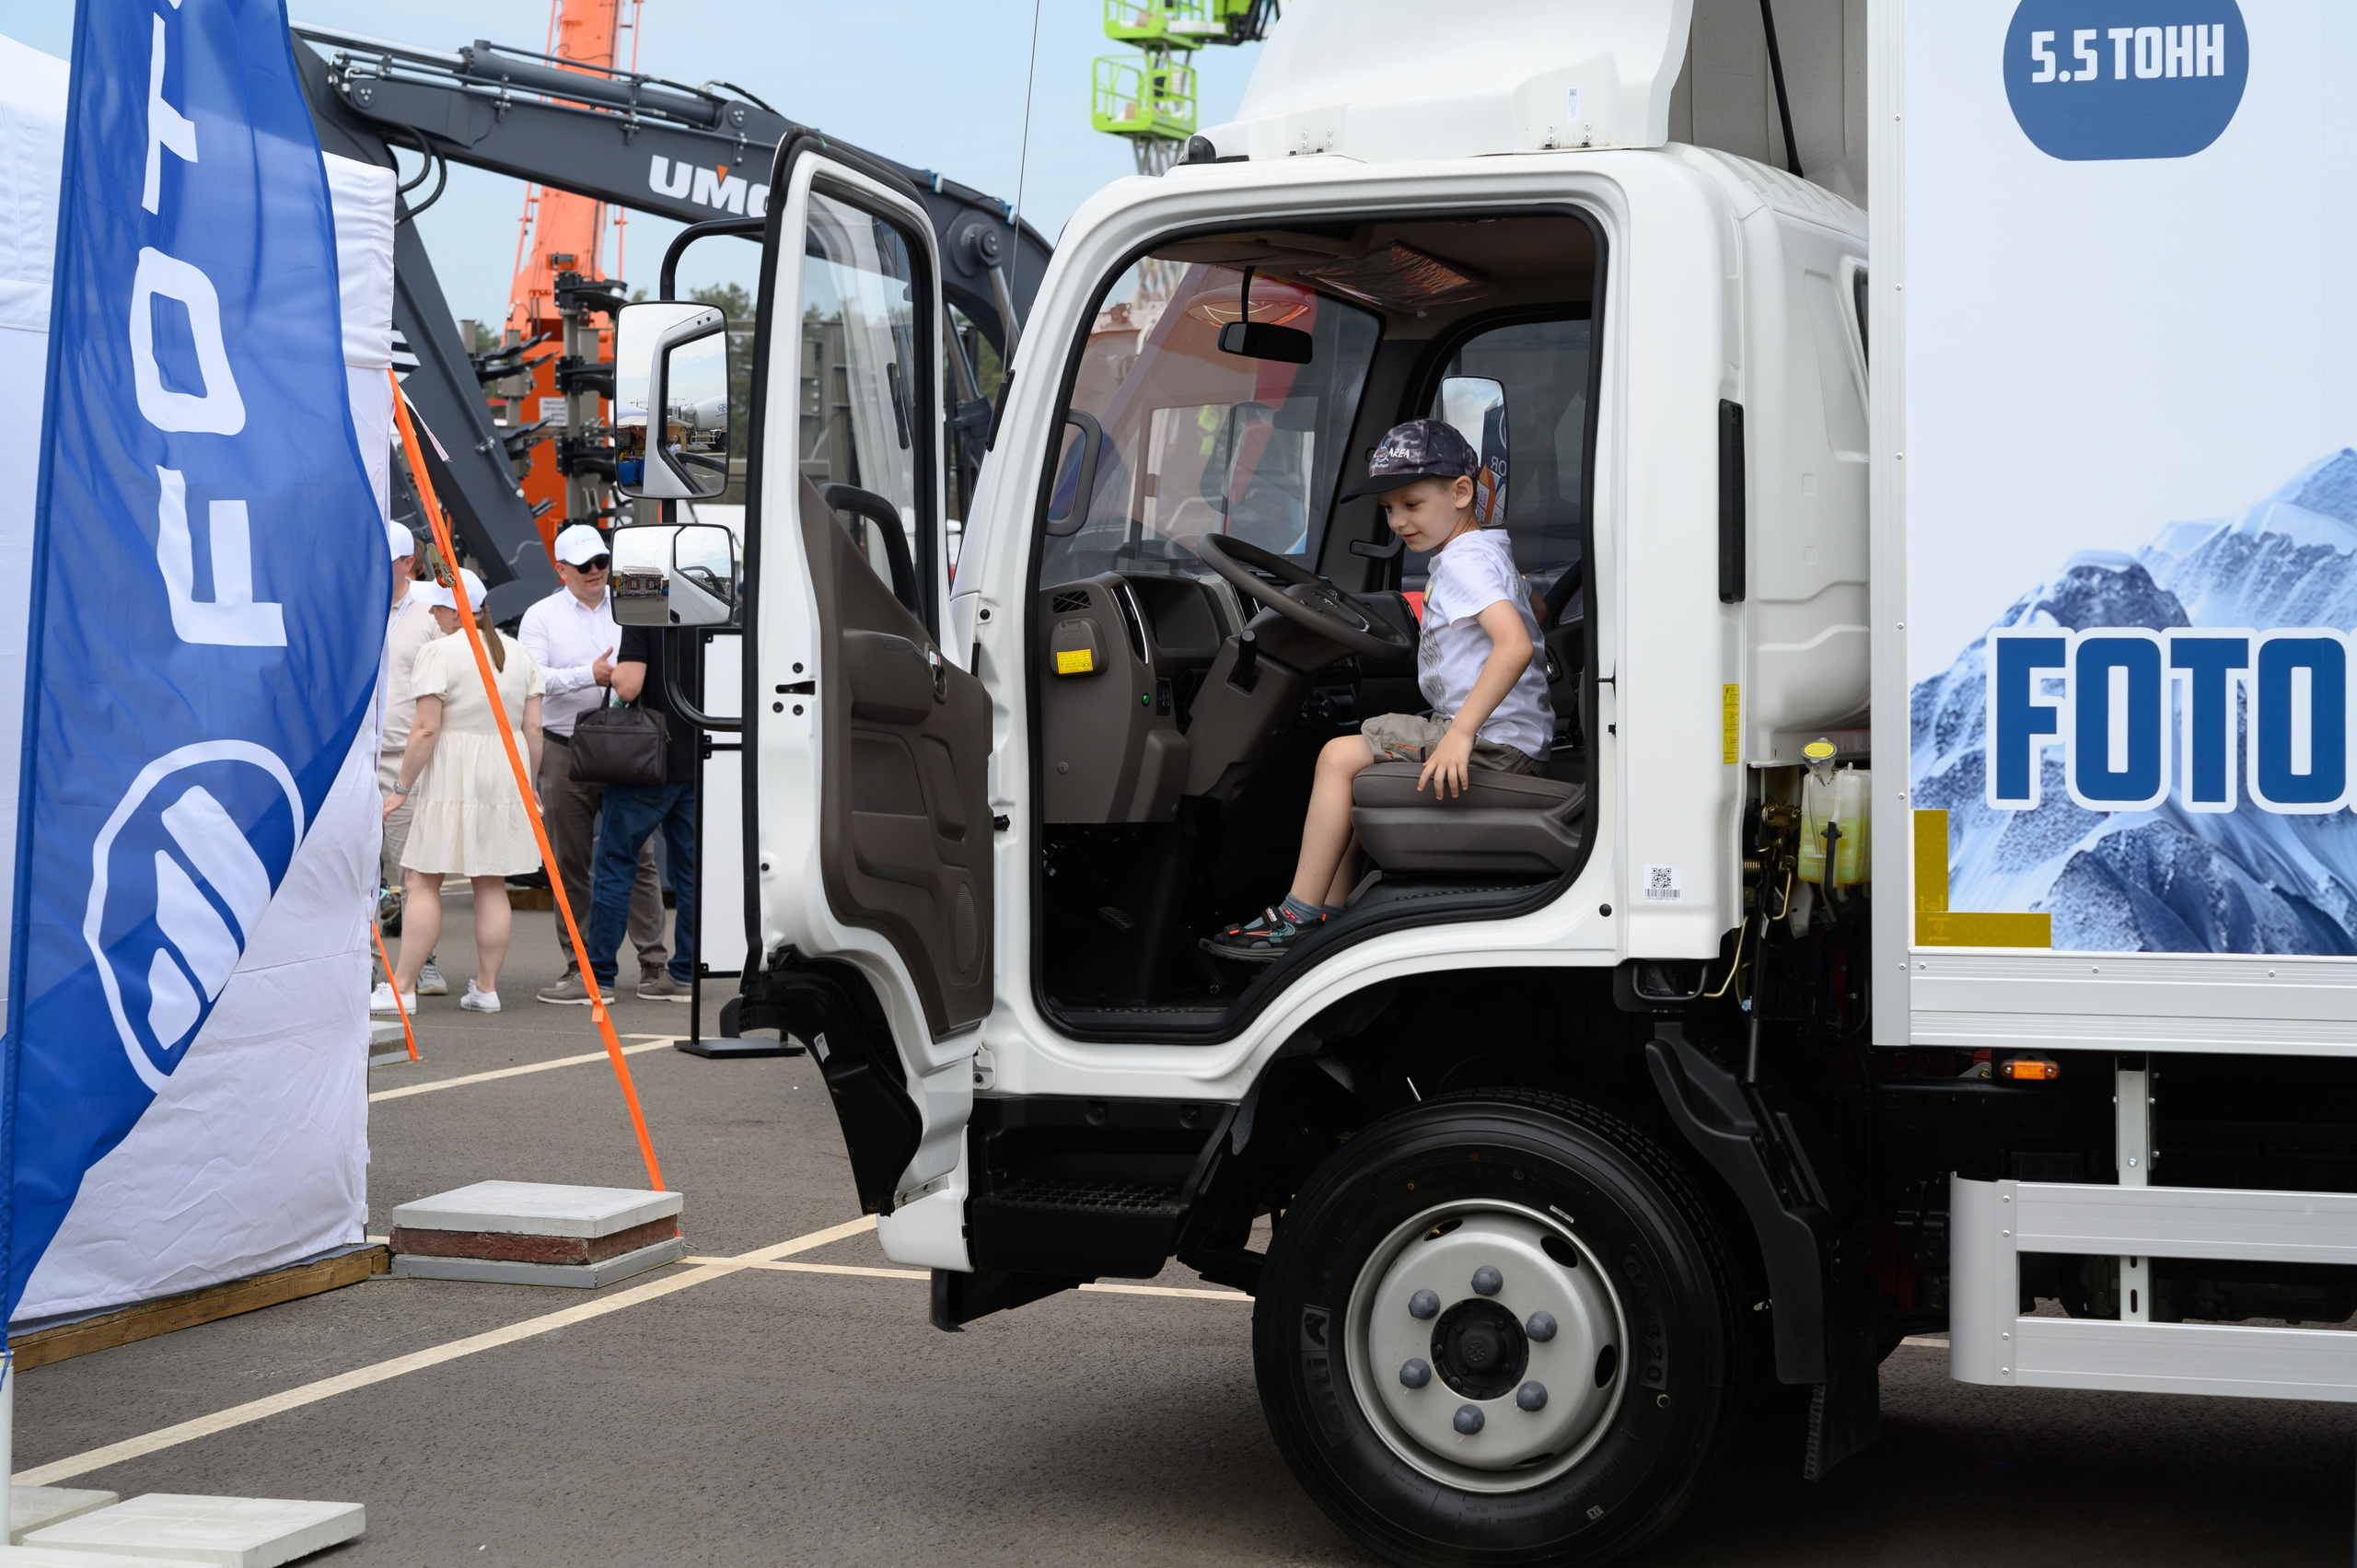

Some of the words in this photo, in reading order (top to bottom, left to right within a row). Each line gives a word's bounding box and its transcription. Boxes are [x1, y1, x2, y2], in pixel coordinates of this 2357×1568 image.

[2031, 29, 2097, 84] 5.5
[2107, 24, 2224, 80] ТОНН
[129, 0, 287, 646] FOT
[1991, 633, 2357, 809] FOTO
